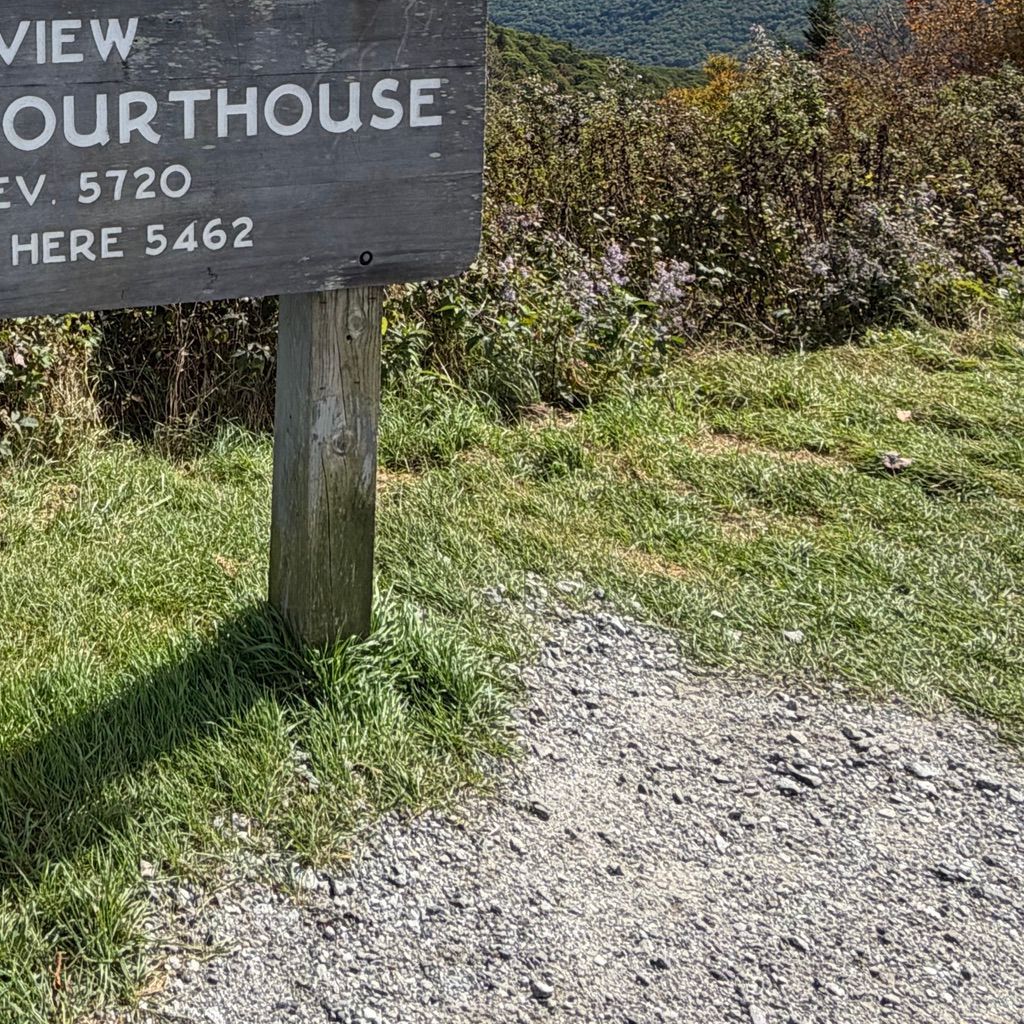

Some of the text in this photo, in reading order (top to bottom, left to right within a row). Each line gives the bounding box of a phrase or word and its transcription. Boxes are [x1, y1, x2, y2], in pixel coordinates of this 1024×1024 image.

[78, 164, 192, 204] 5720
[11, 226, 124, 266] HERE
[145, 216, 253, 256] 5462
